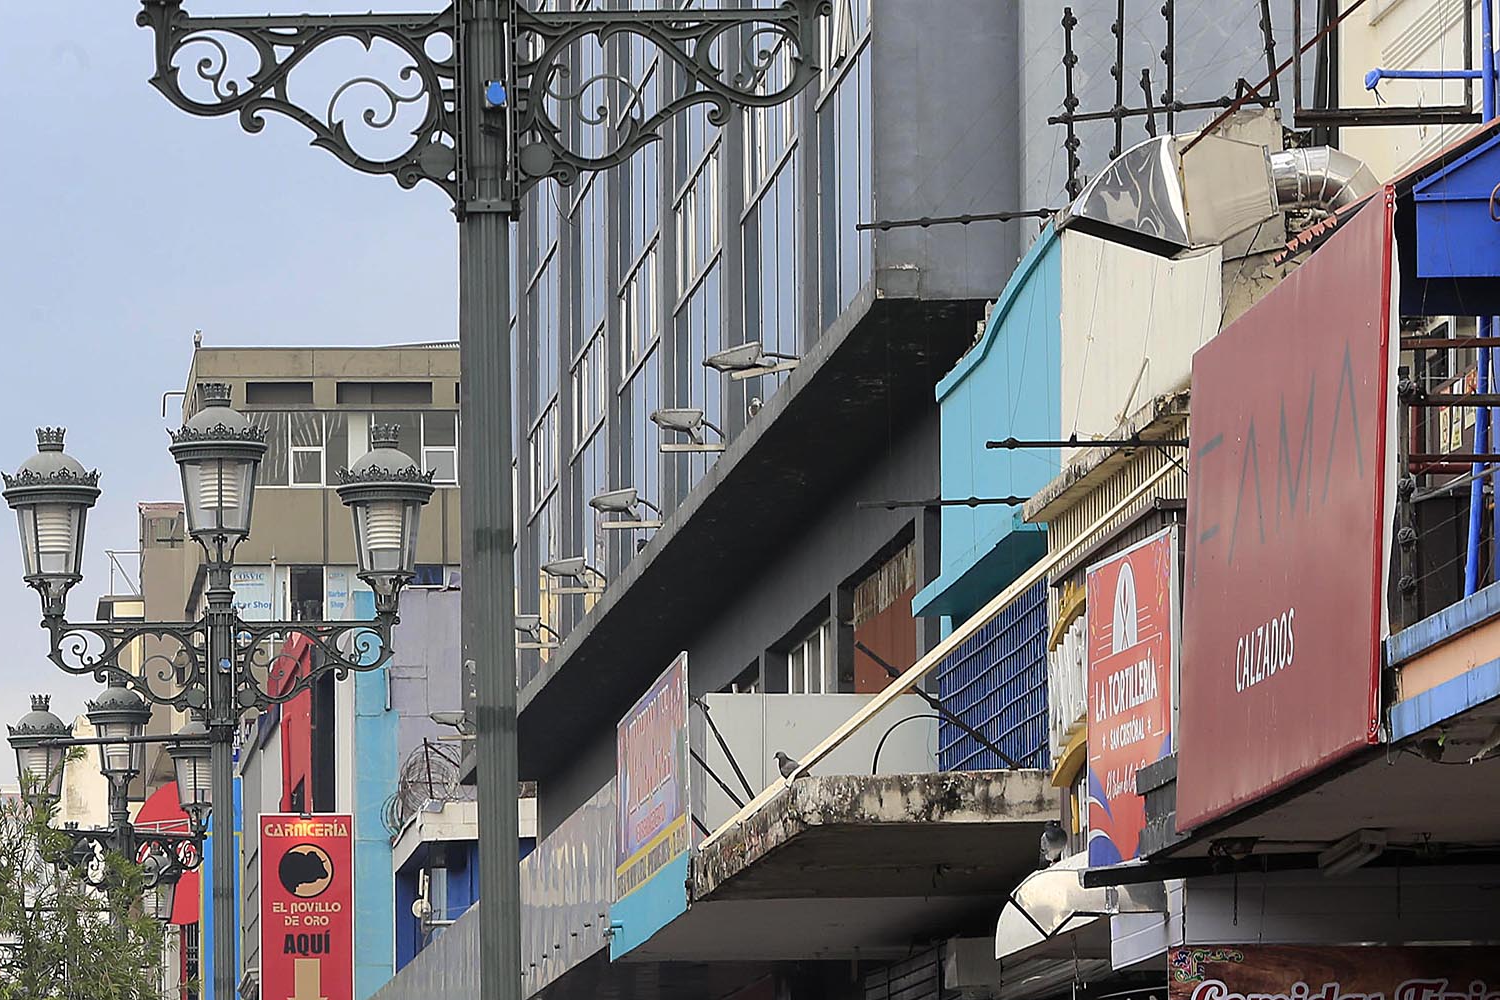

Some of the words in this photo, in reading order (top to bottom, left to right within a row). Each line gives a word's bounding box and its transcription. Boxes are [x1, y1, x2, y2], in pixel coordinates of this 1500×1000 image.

[1235, 606, 1296, 693] CALZADOS
[1095, 679, 1107, 723] LA
[1108, 646, 1158, 717] TORTILLERÍA
[264, 819, 349, 837] CARNICERÍA
[272, 902, 288, 914] EL
[284, 915, 300, 926] DE
[303, 915, 330, 926] ORO
[283, 930, 331, 956] AQUÍ
